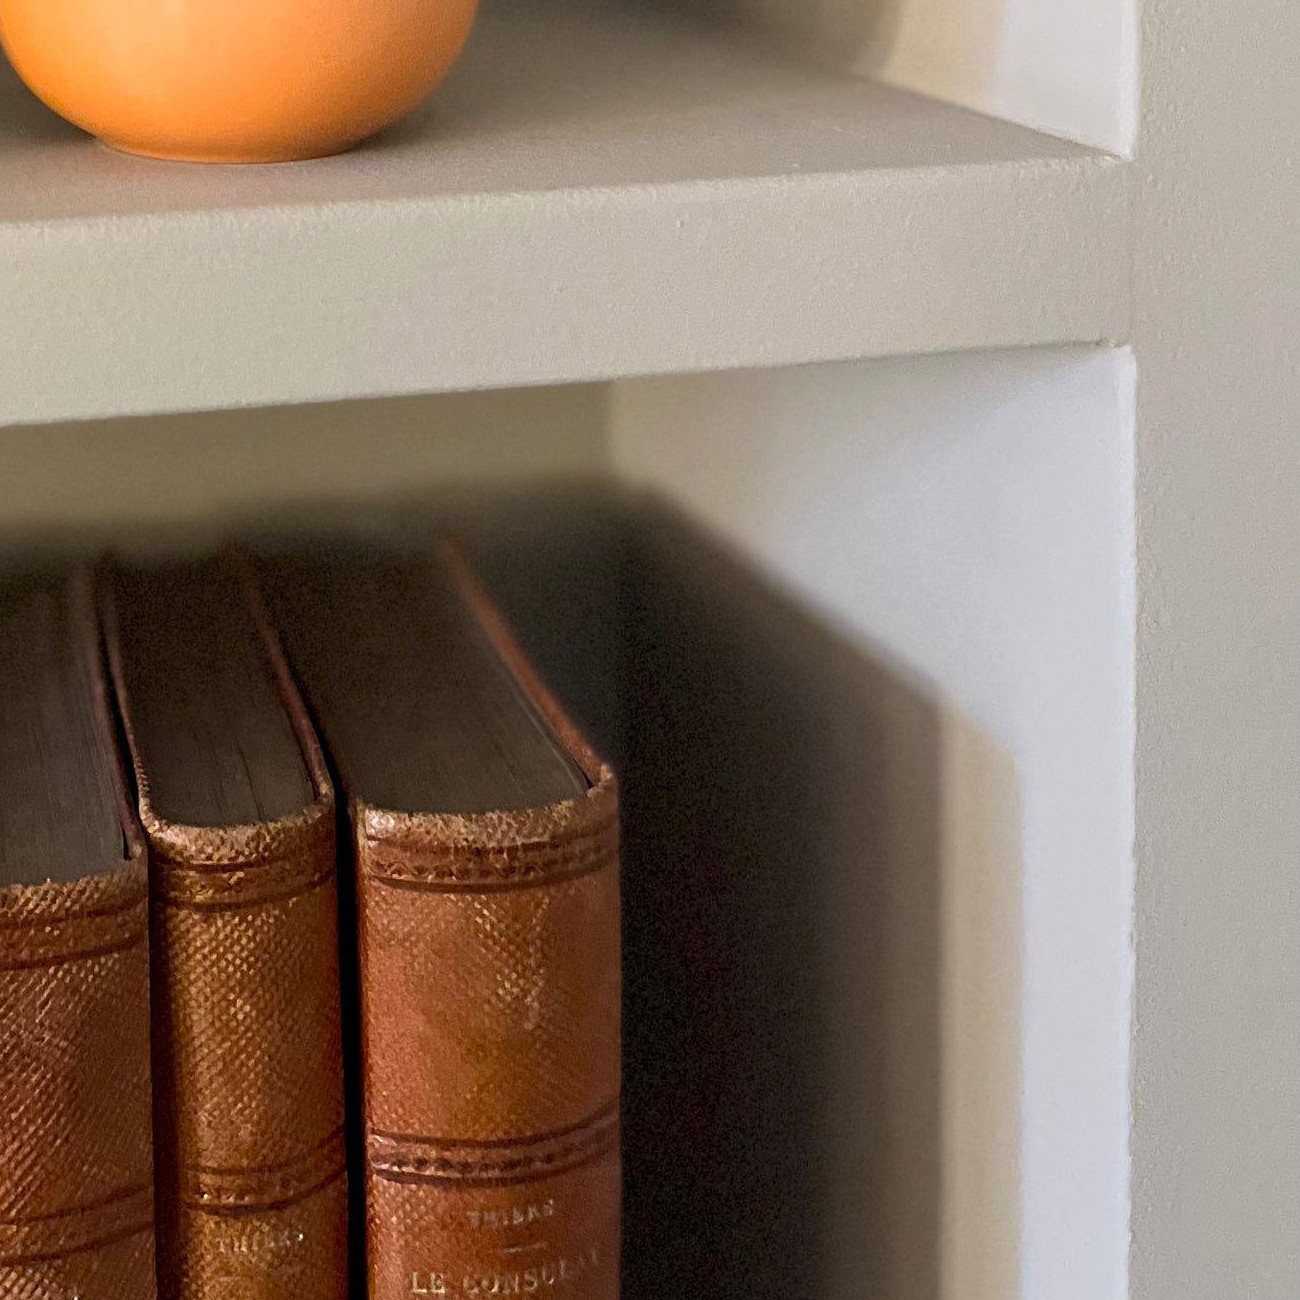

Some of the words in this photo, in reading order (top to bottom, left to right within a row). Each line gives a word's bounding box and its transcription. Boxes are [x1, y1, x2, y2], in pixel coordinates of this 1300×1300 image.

[216, 1224, 307, 1253] THI
[411, 1271, 446, 1294] LE
[461, 1247, 599, 1294] CONSUL
